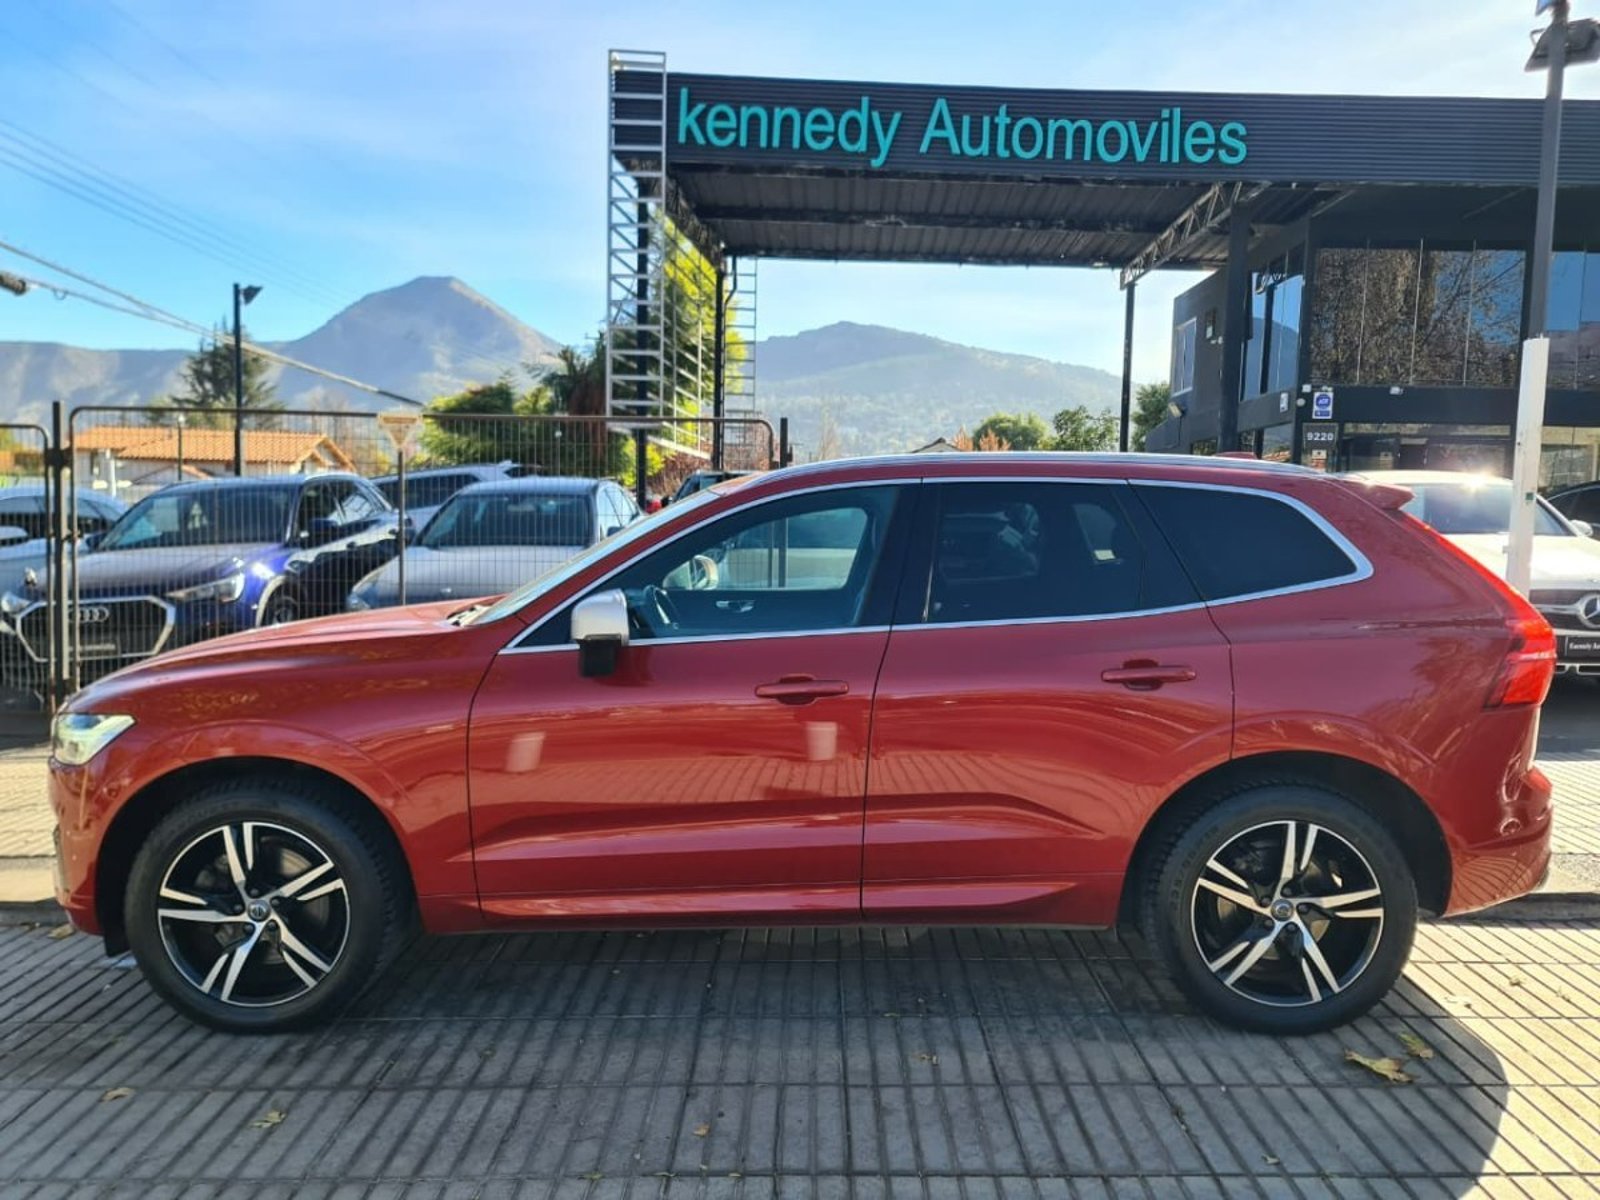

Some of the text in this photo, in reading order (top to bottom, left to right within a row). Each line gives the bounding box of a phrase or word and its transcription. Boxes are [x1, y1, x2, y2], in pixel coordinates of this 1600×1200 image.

[678, 87, 1248, 168] kennedy Automoviles
[1306, 431, 1335, 441] 9220
